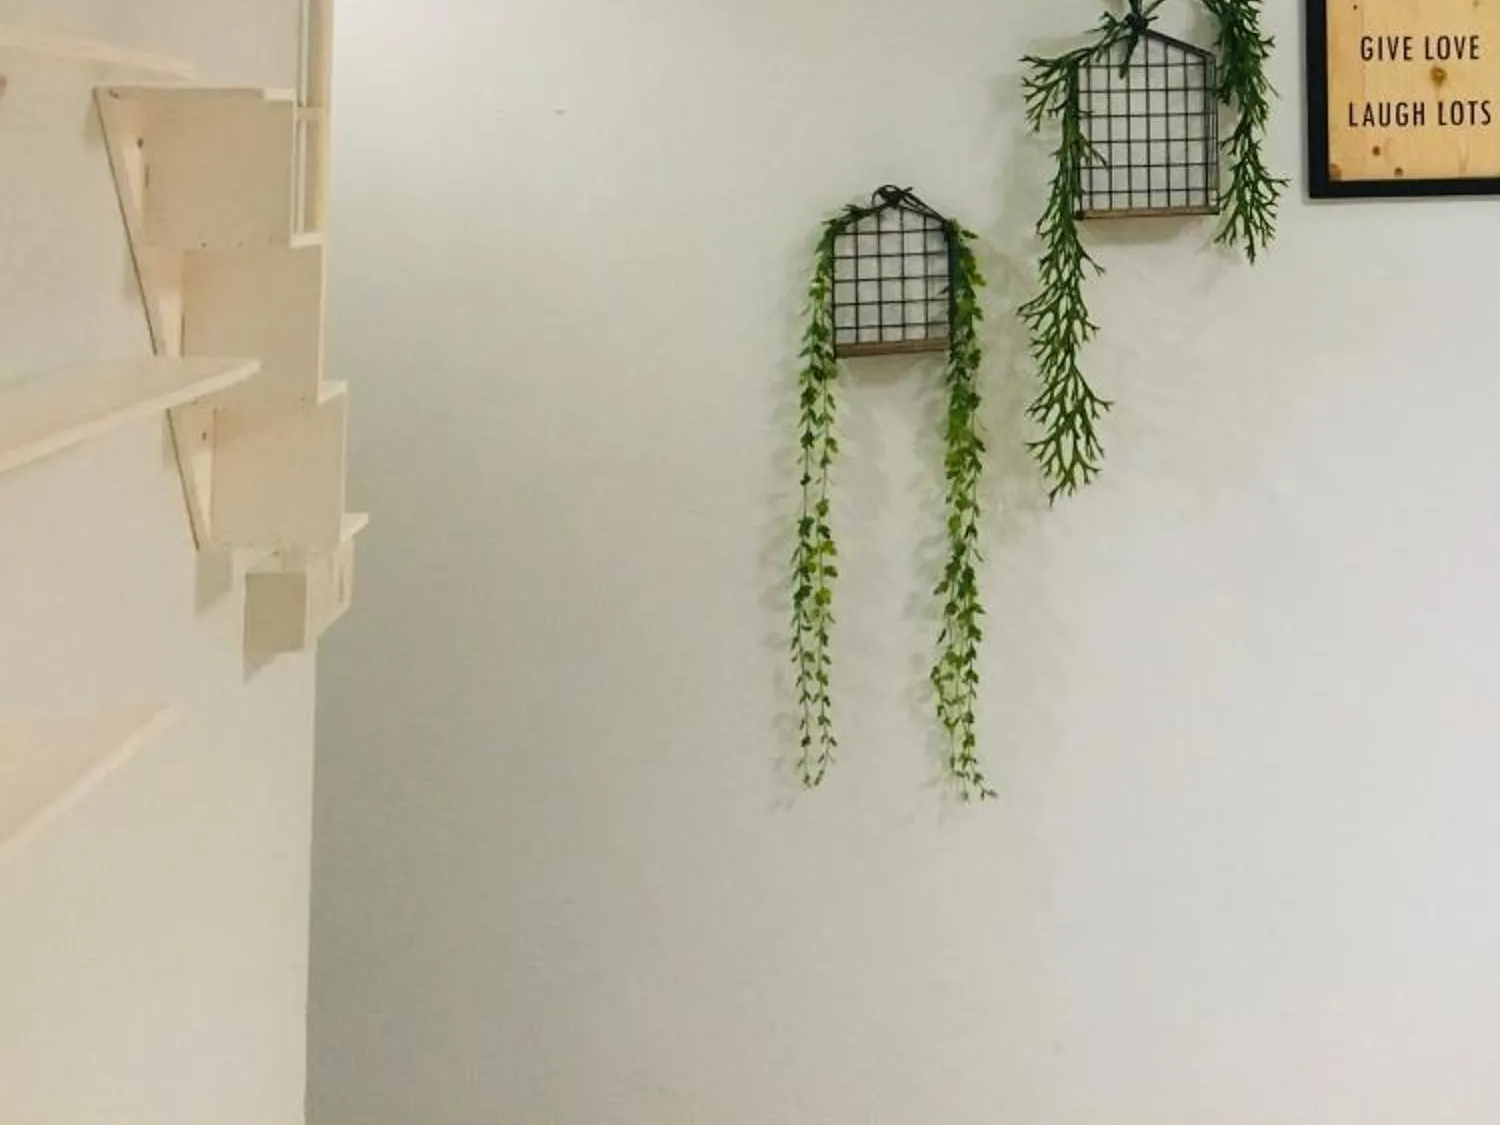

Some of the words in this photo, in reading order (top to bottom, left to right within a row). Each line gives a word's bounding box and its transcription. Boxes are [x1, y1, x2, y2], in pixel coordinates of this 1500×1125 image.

[1360, 35, 1413, 62] GIVE
[1424, 35, 1480, 61] LOVE
[1348, 102, 1425, 128] LAUGH
[1437, 100, 1492, 126] LOTS
